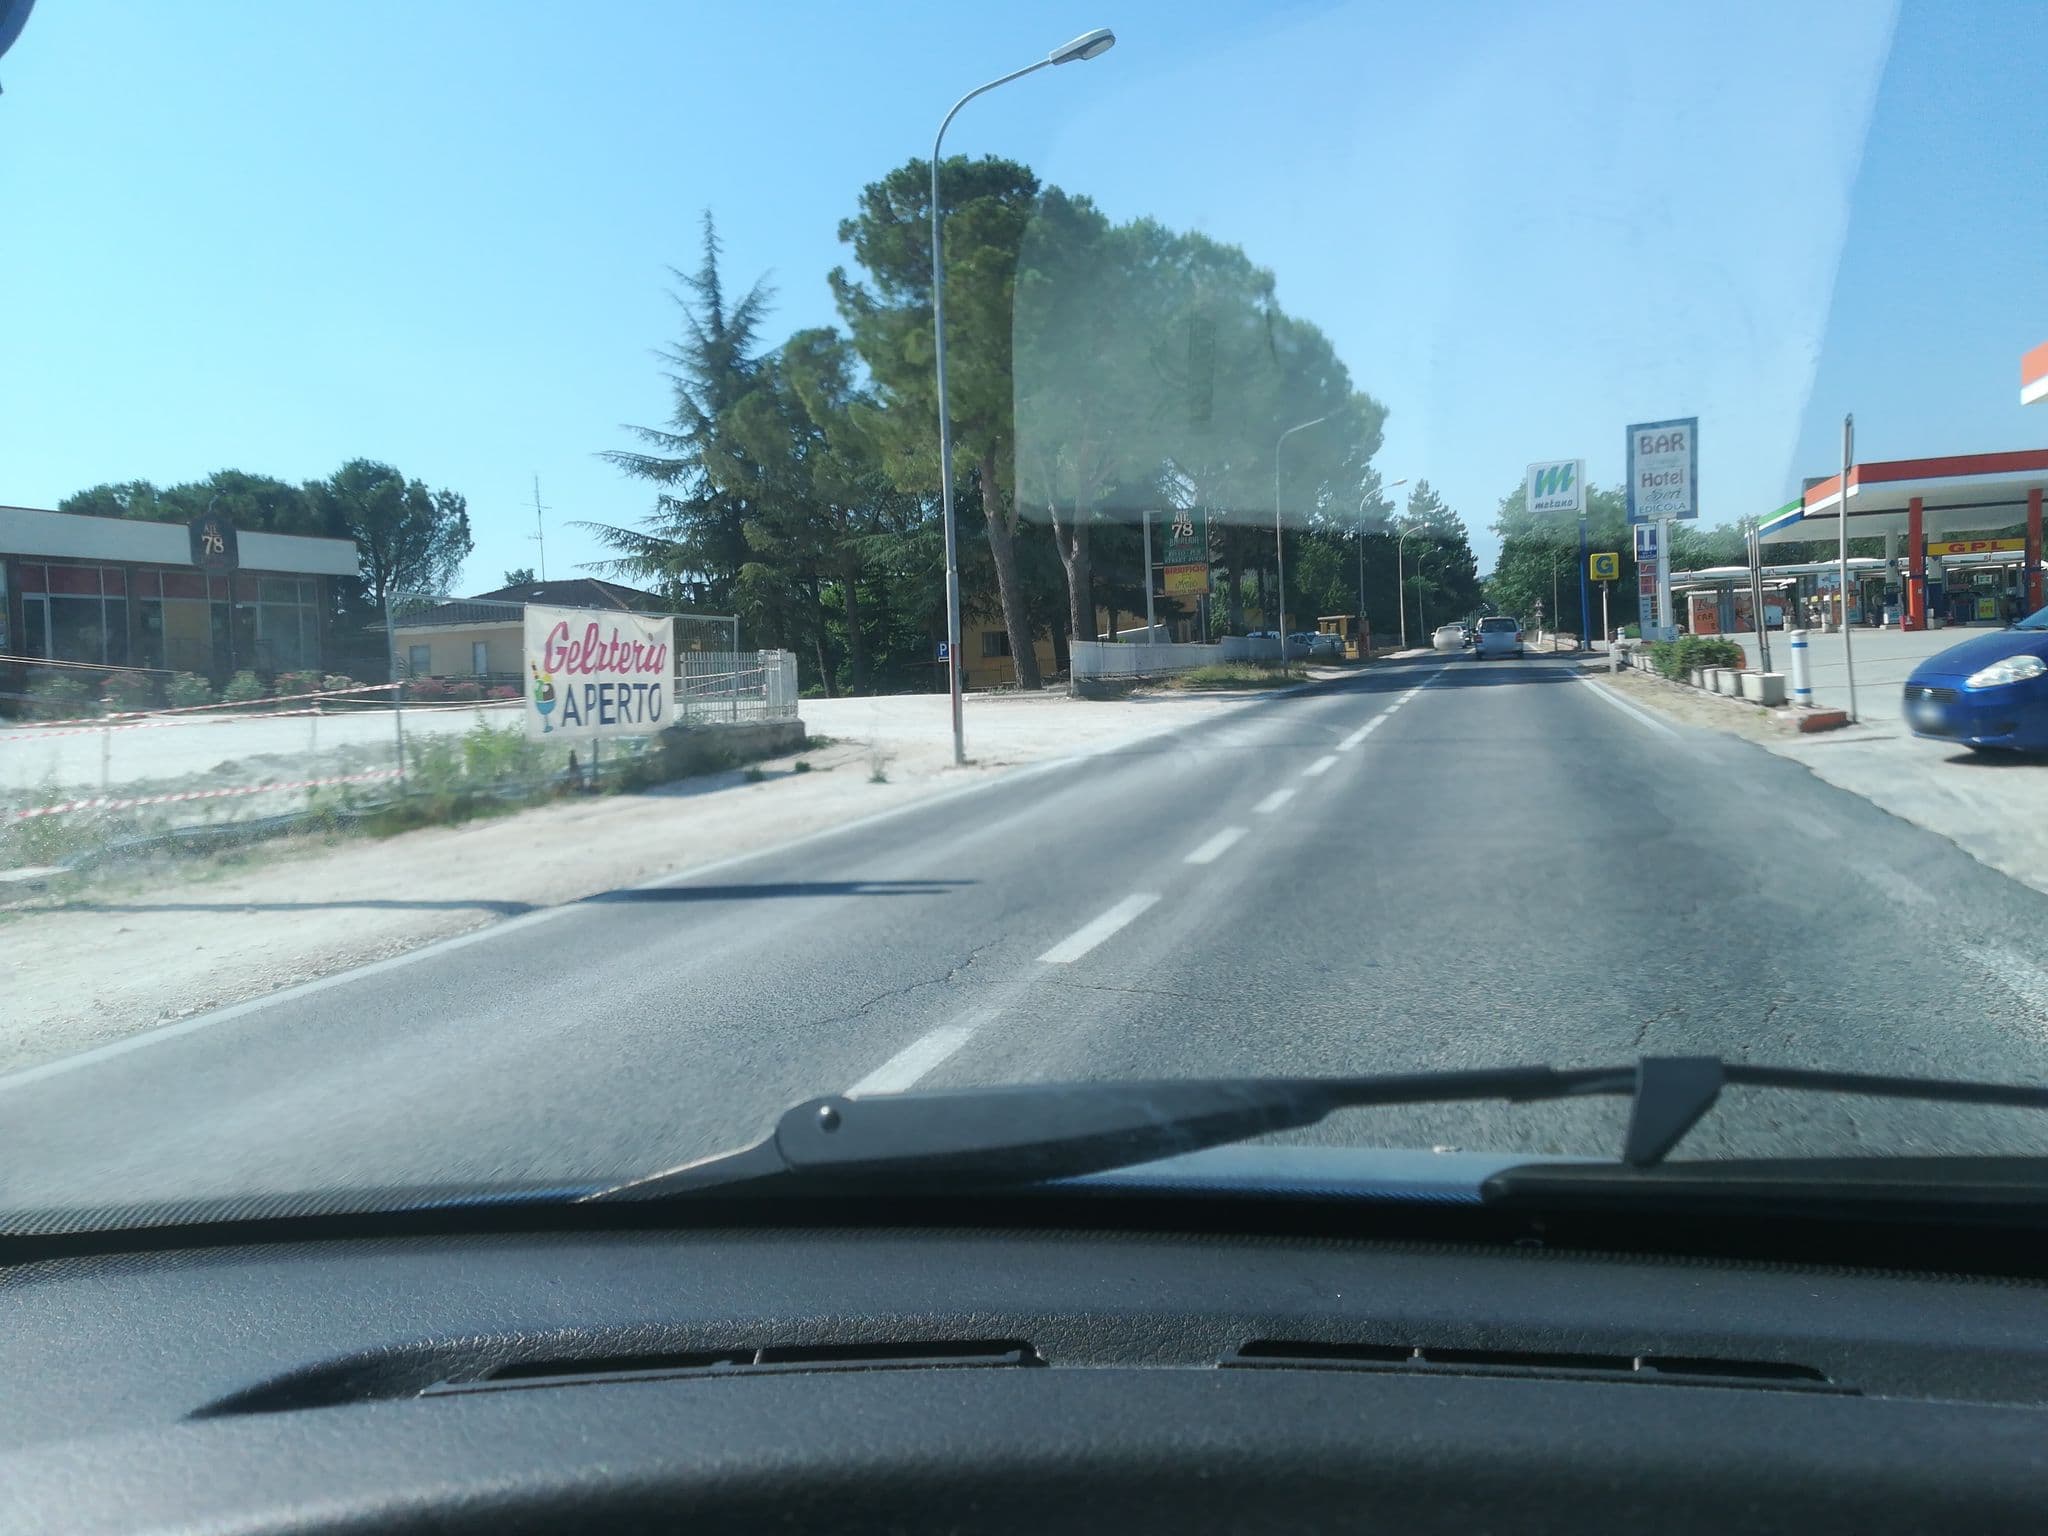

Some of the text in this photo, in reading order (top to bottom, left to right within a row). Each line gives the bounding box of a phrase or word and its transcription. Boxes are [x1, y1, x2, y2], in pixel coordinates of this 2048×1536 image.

[1640, 433, 1684, 455] BAR
[1642, 469, 1683, 488] Hotel
[1640, 502, 1685, 513] EDICOLA
[1172, 523, 1193, 539] 78
[201, 535, 224, 555] 78
[1948, 541, 2005, 552] GPL
[543, 621, 667, 675] Gelateria
[940, 643, 947, 656] P
[561, 682, 662, 727] APERTO
